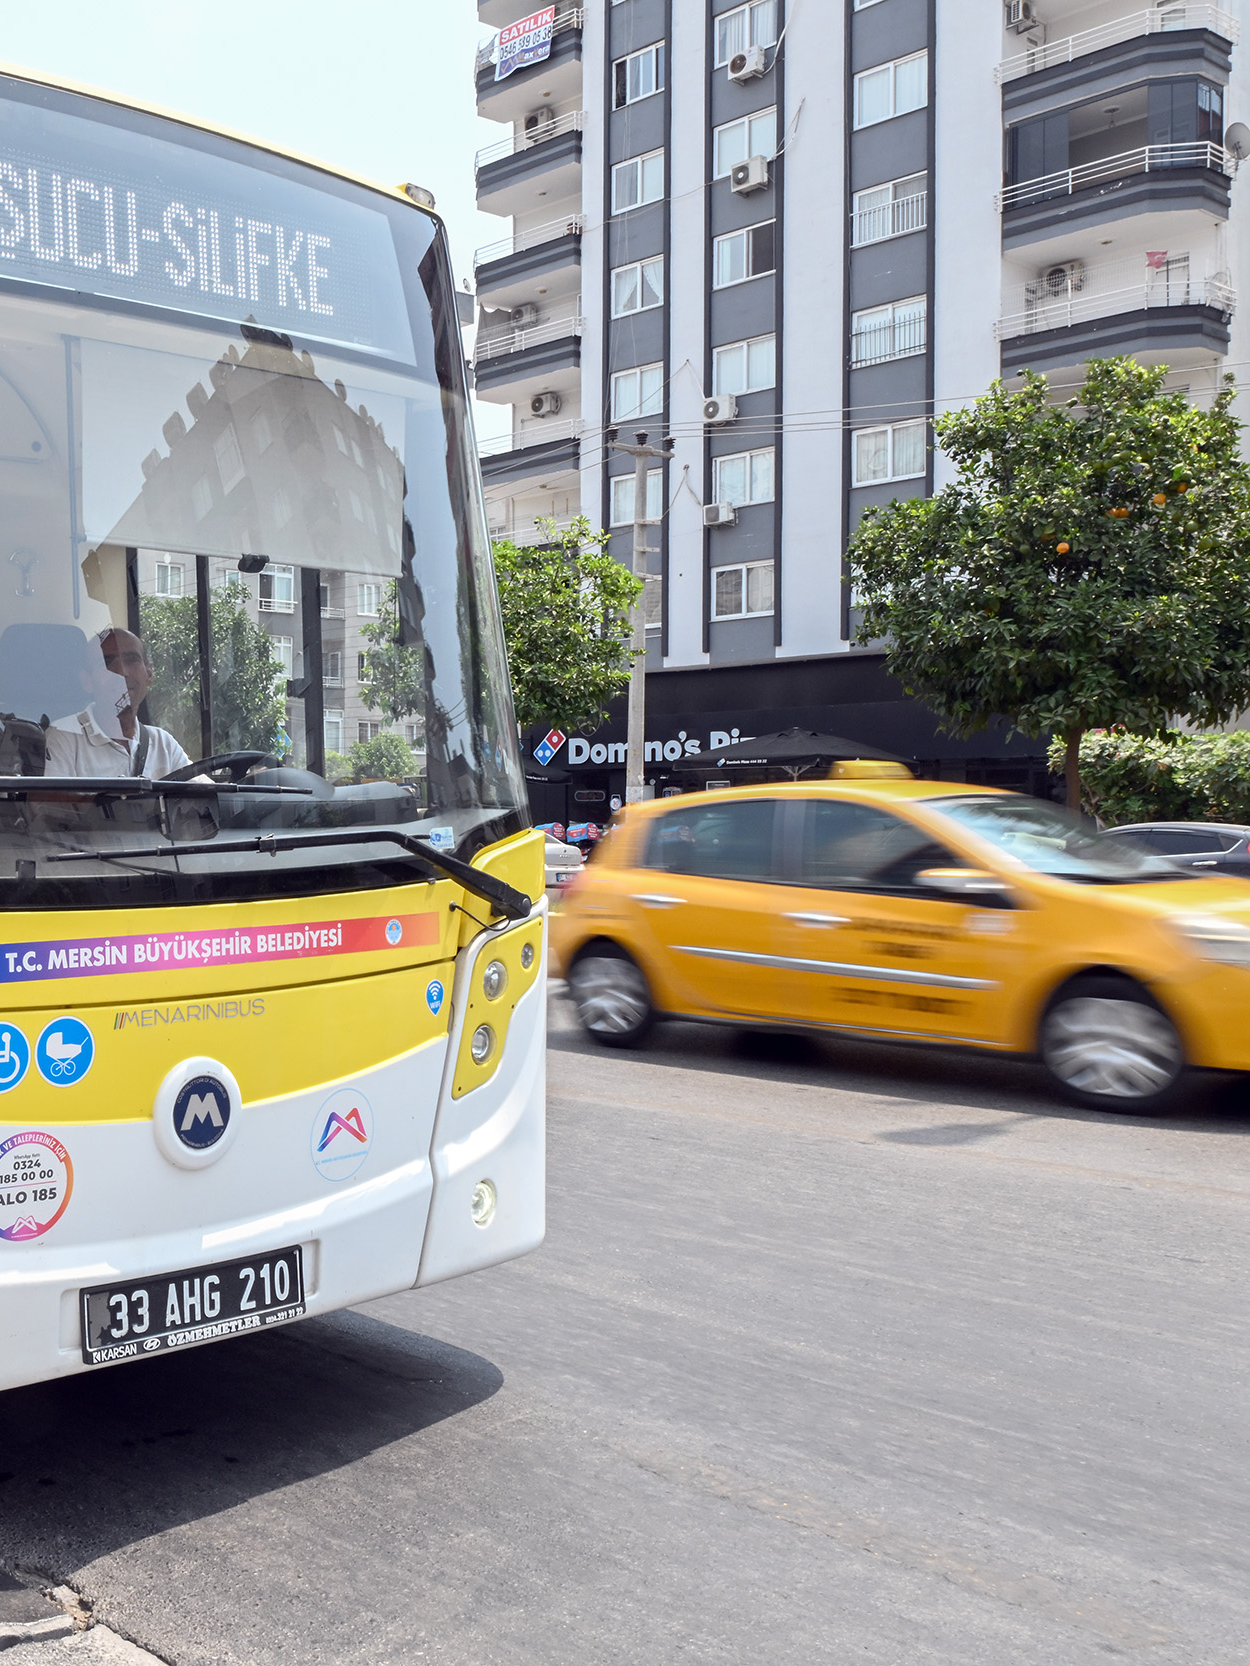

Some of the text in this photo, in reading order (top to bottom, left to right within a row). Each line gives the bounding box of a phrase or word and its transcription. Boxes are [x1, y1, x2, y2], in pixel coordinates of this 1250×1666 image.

[501, 10, 552, 43] SATILIK
[568, 731, 701, 765] Domno's
[5, 923, 343, 973] T.C. MERSİN BÜYÜKŞEHİR BELEDİYESİ
[122, 998, 266, 1028] MENARINIBUS
[3, 1141, 13, 1151] VE
[13, 1134, 57, 1149] TALEPLERİNİZ
[54, 1143, 67, 1160] İÇİN
[0, 1169, 54, 1184] 185 00 00
[13, 1159, 41, 1170] 0324
[32, 1187, 57, 1202] 185
[109, 1259, 290, 1338] 33 AHG 210
[100, 1344, 137, 1362] KARSAN
[167, 1315, 261, 1347] ÖZMEHMETLER
